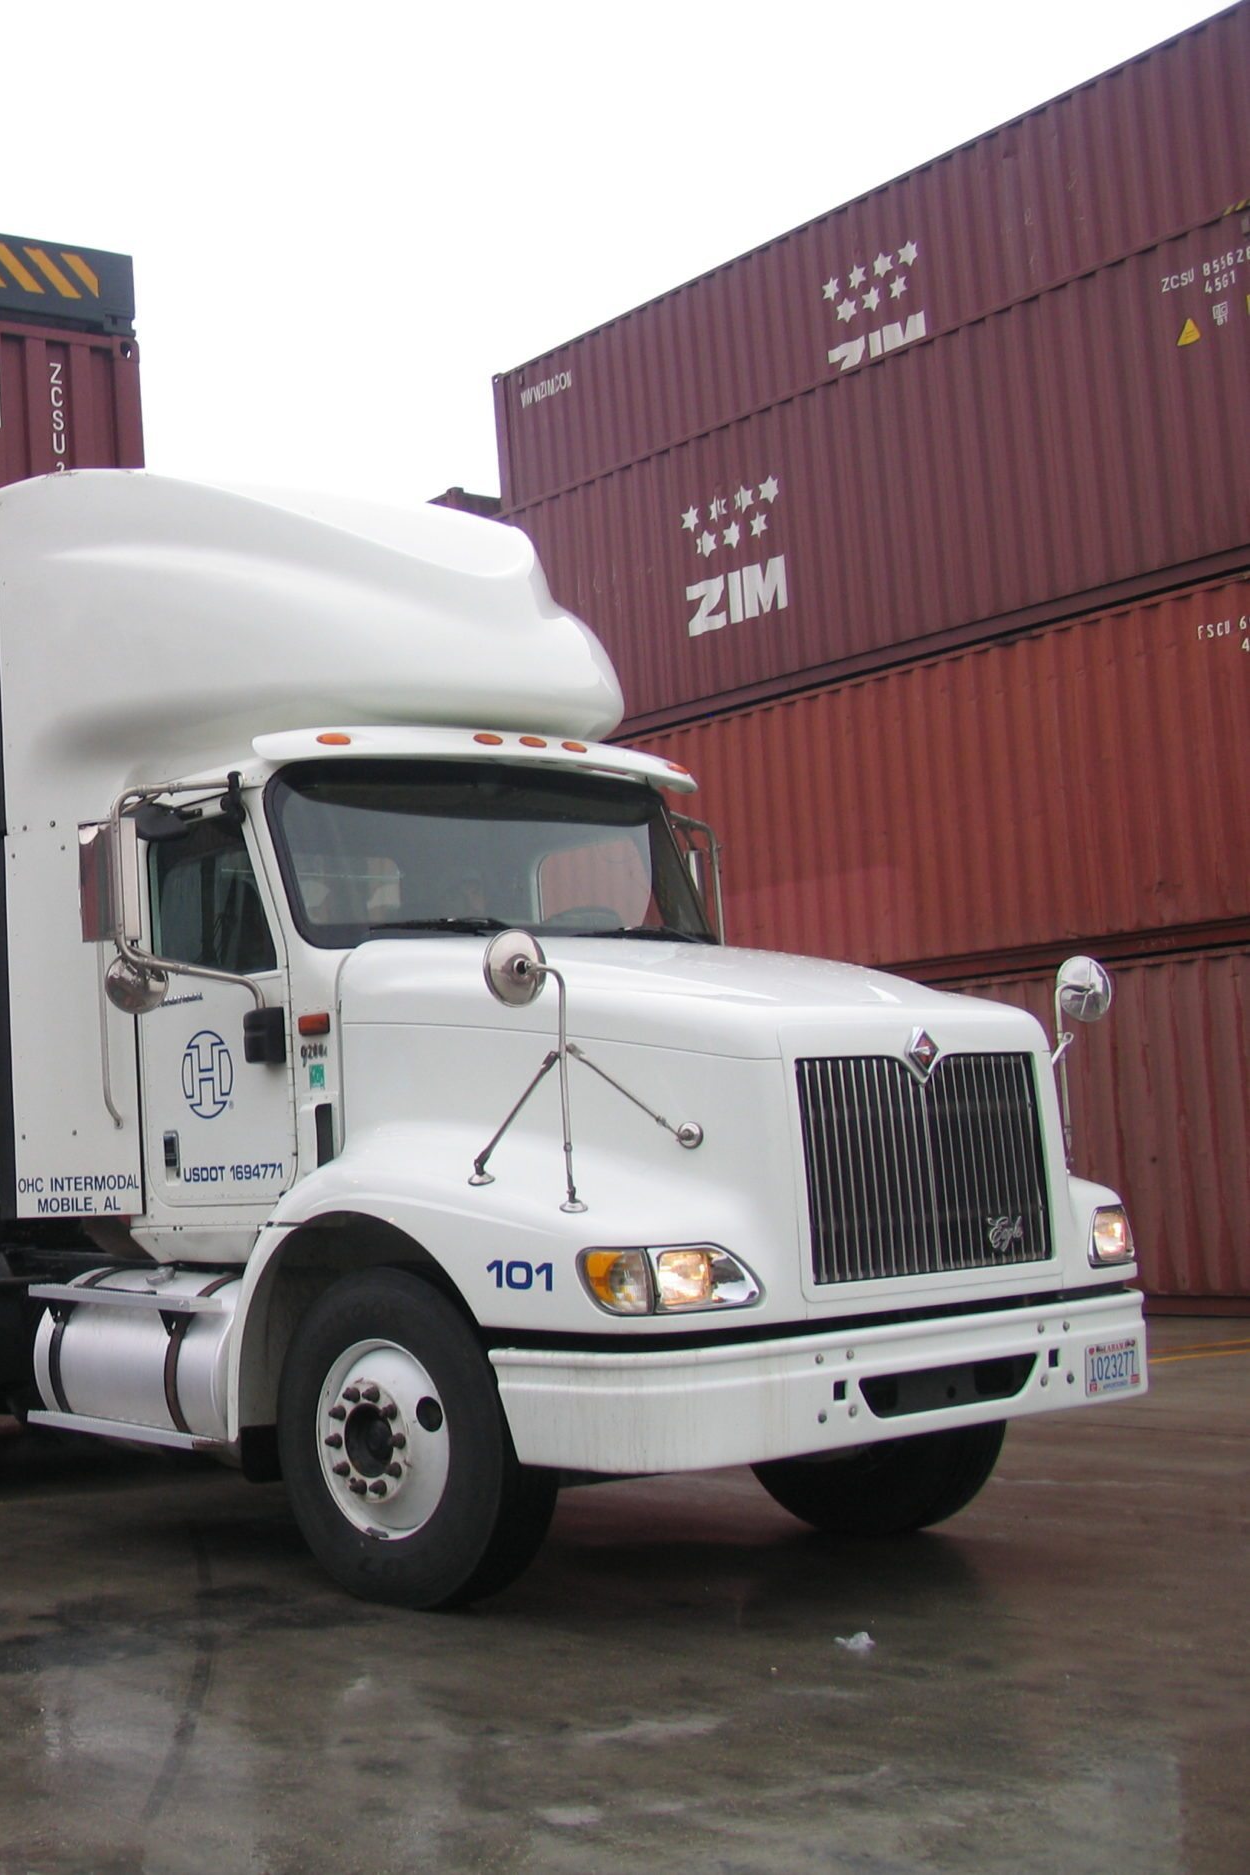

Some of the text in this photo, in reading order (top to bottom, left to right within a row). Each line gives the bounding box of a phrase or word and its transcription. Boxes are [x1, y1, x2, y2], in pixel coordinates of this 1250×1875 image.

[1161, 267, 1195, 293] ZCSU
[827, 309, 927, 372] ZIM
[49, 362, 66, 455] ZCSU
[686, 553, 788, 637] ZIM
[1197, 620, 1231, 640] FSCU
[17, 1174, 139, 1193] OHC INTERMODAL
[183, 1163, 283, 1182] USDOT 1694771
[37, 1196, 121, 1214] MOBILE, AL
[486, 1259, 553, 1292] 101
[1090, 1350, 1135, 1383] 1023277
